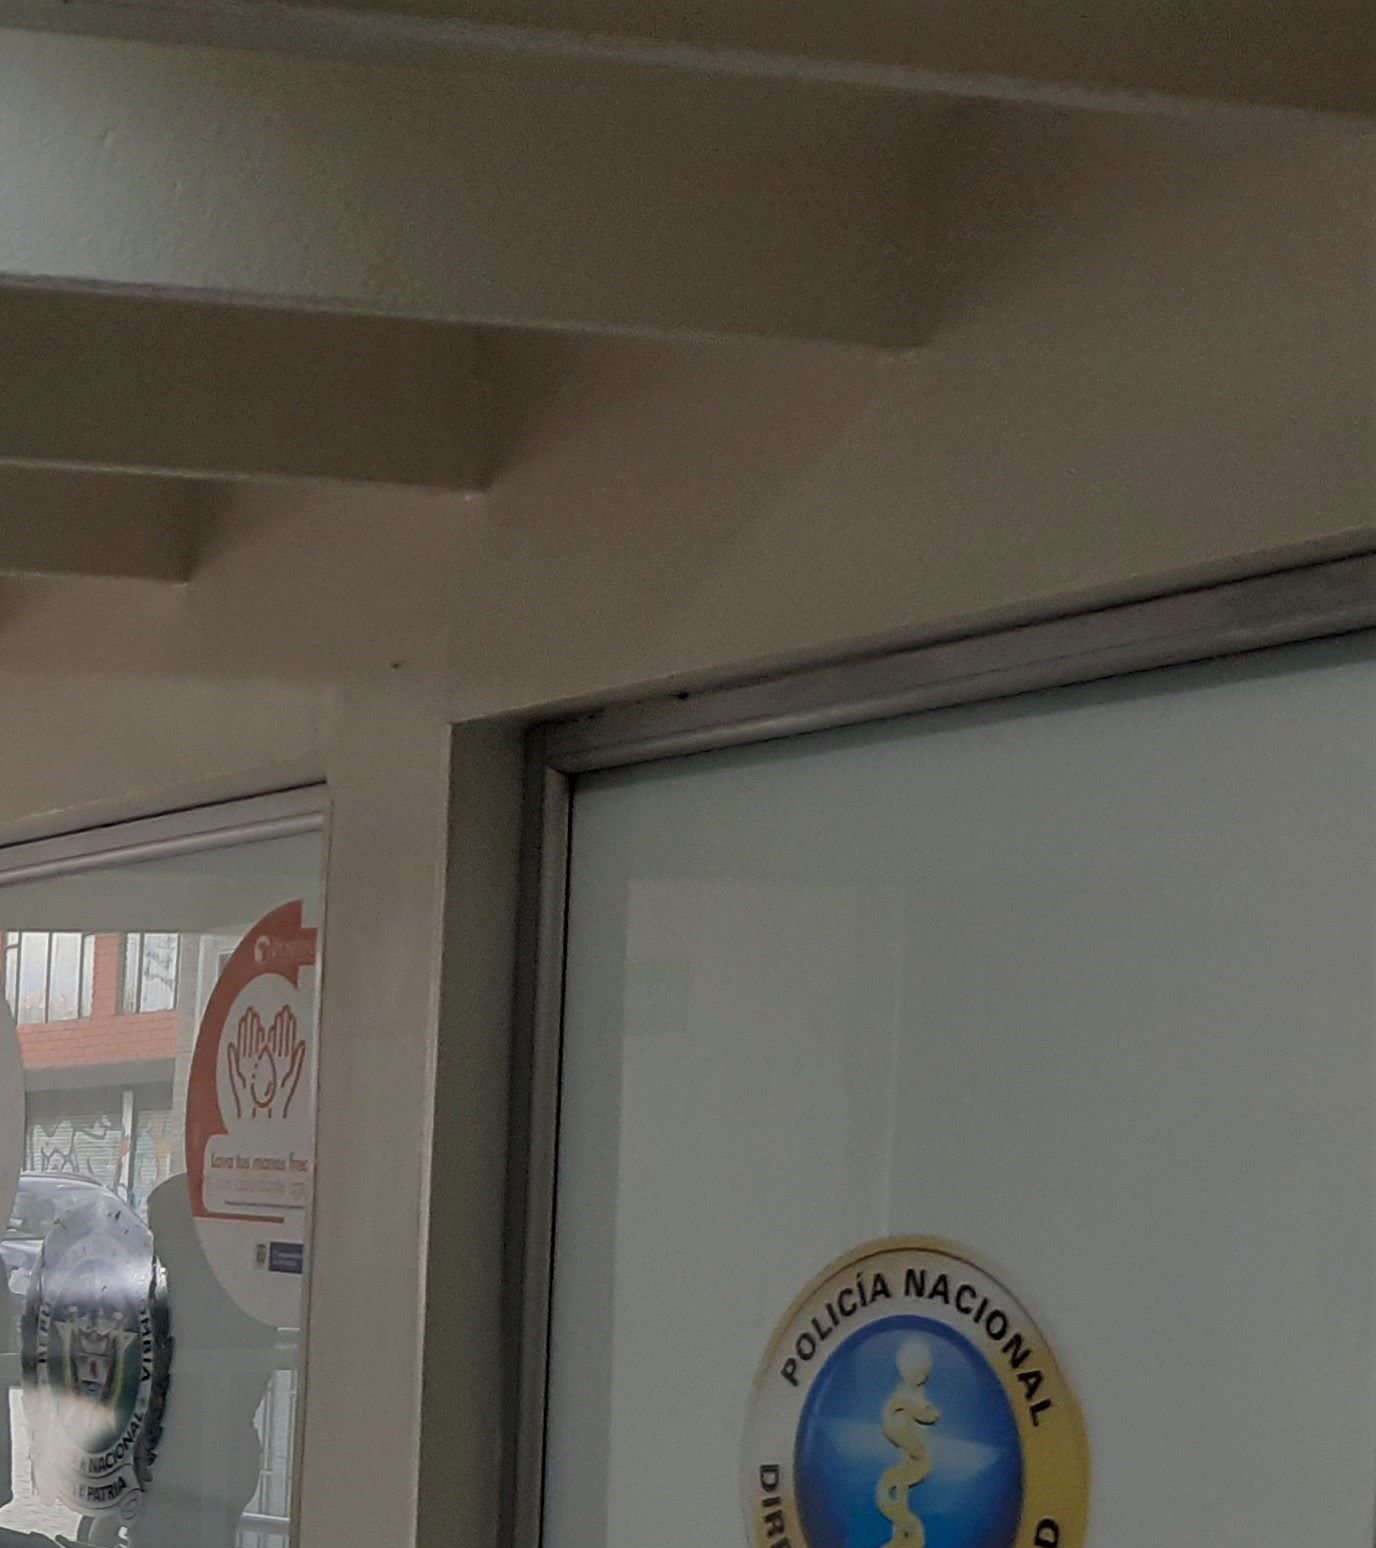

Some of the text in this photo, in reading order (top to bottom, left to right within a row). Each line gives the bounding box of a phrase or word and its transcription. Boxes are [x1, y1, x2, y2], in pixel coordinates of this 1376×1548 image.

[781, 1267, 1052, 1427] POLICÍA NACIONAL
[88, 1412, 143, 1474] NACIONAL
